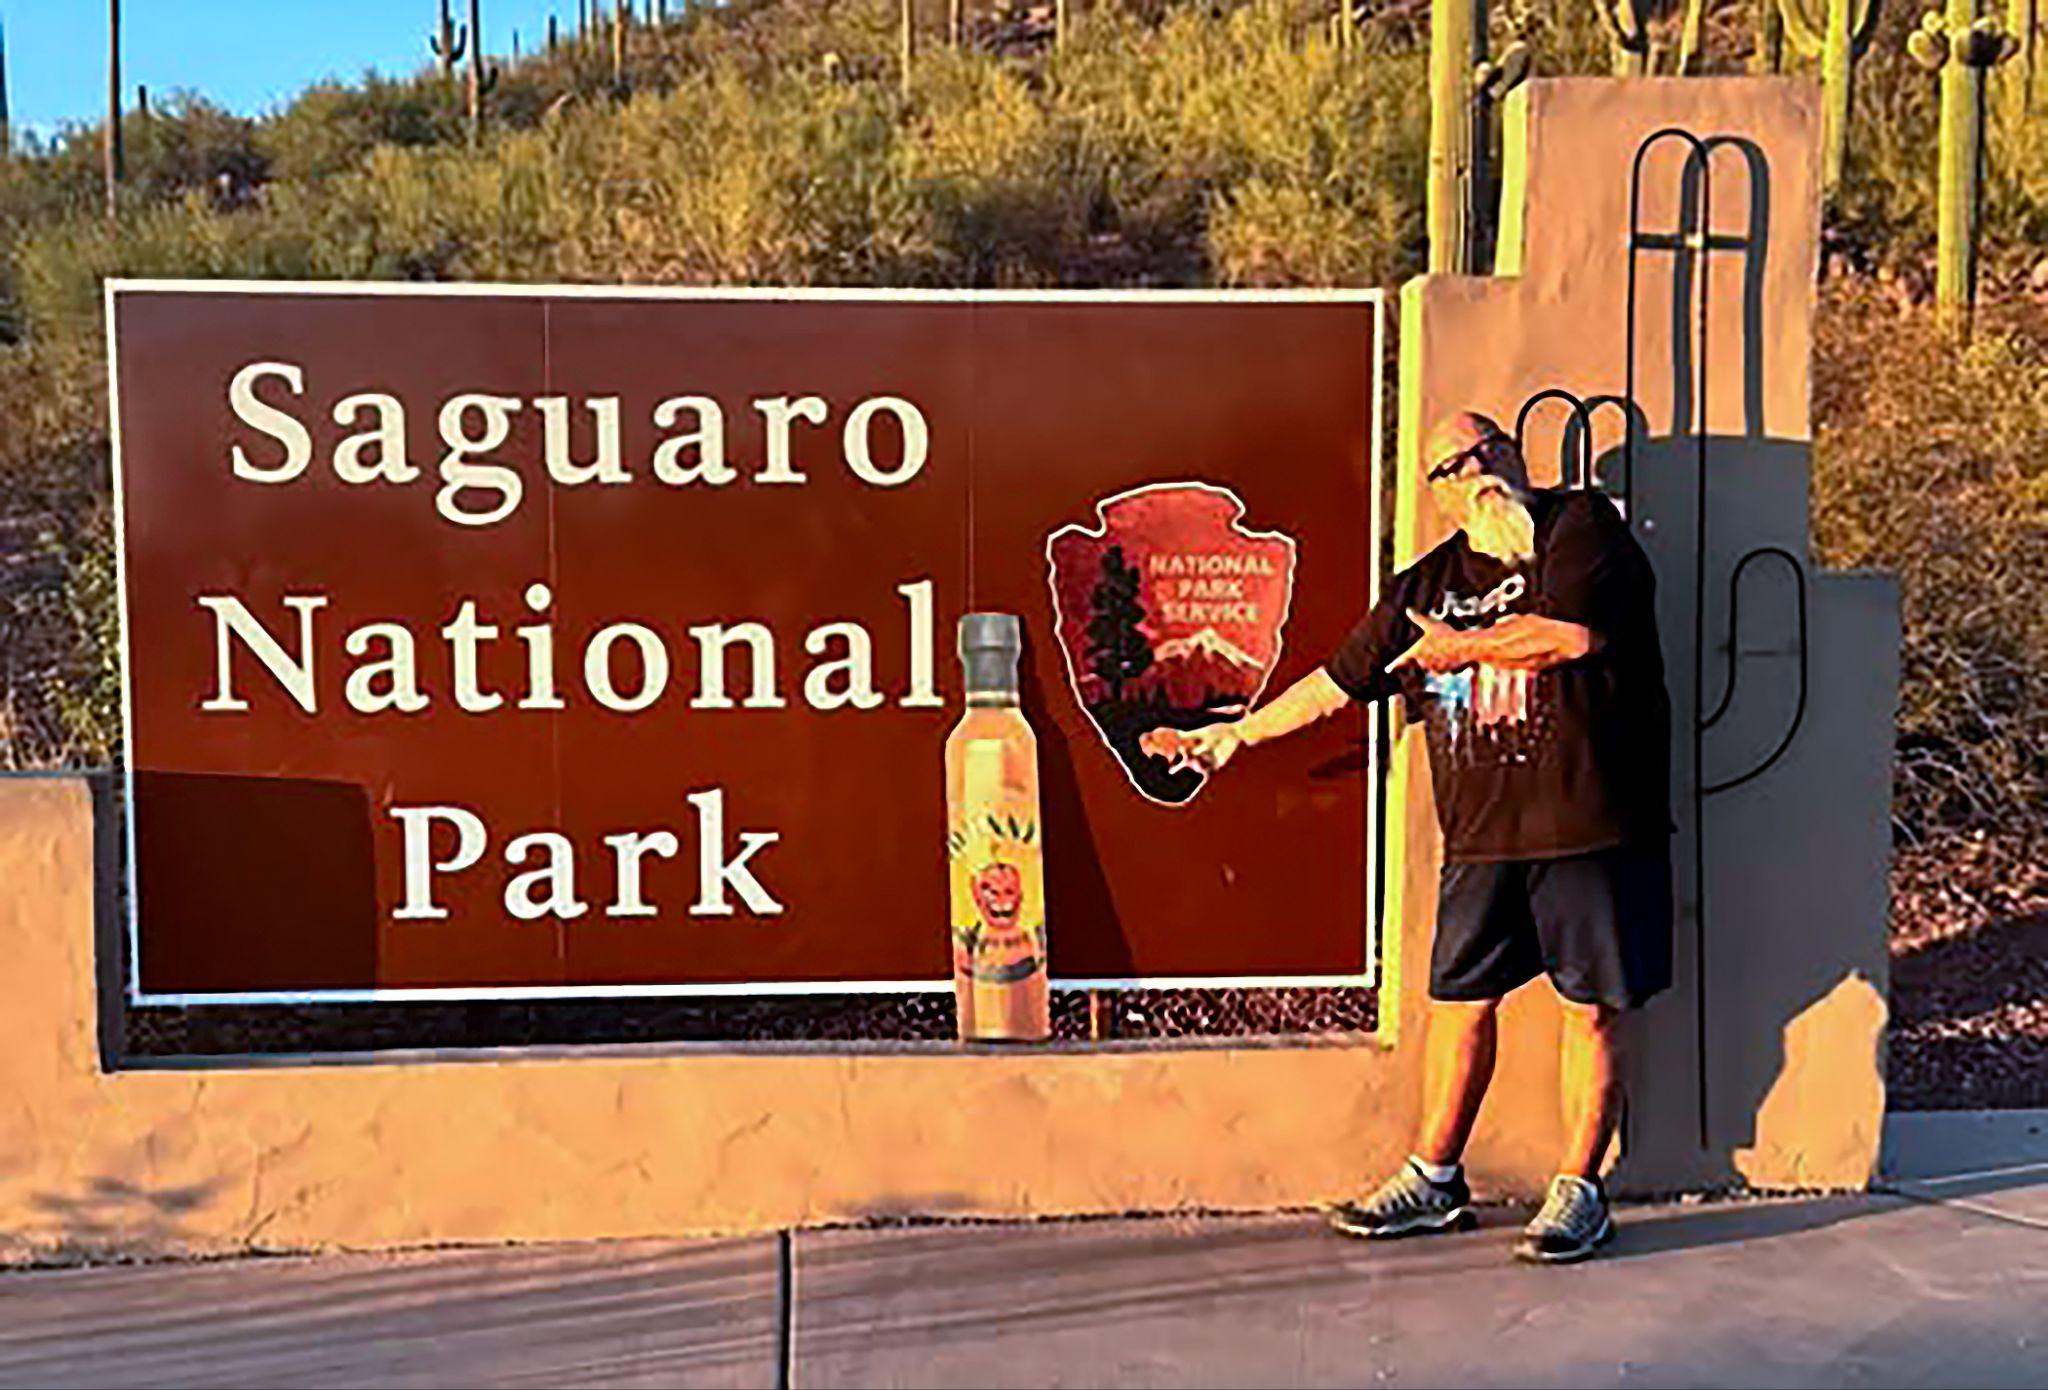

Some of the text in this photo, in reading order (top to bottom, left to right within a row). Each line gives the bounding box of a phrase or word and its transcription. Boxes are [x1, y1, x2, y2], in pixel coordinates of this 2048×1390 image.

[229, 361, 928, 525] Saguaro
[1150, 554, 1274, 577] NATIONAL
[1178, 578, 1243, 599] PARK
[198, 580, 944, 713] National
[1161, 601, 1260, 624] SERVICE
[389, 788, 784, 919] Park
